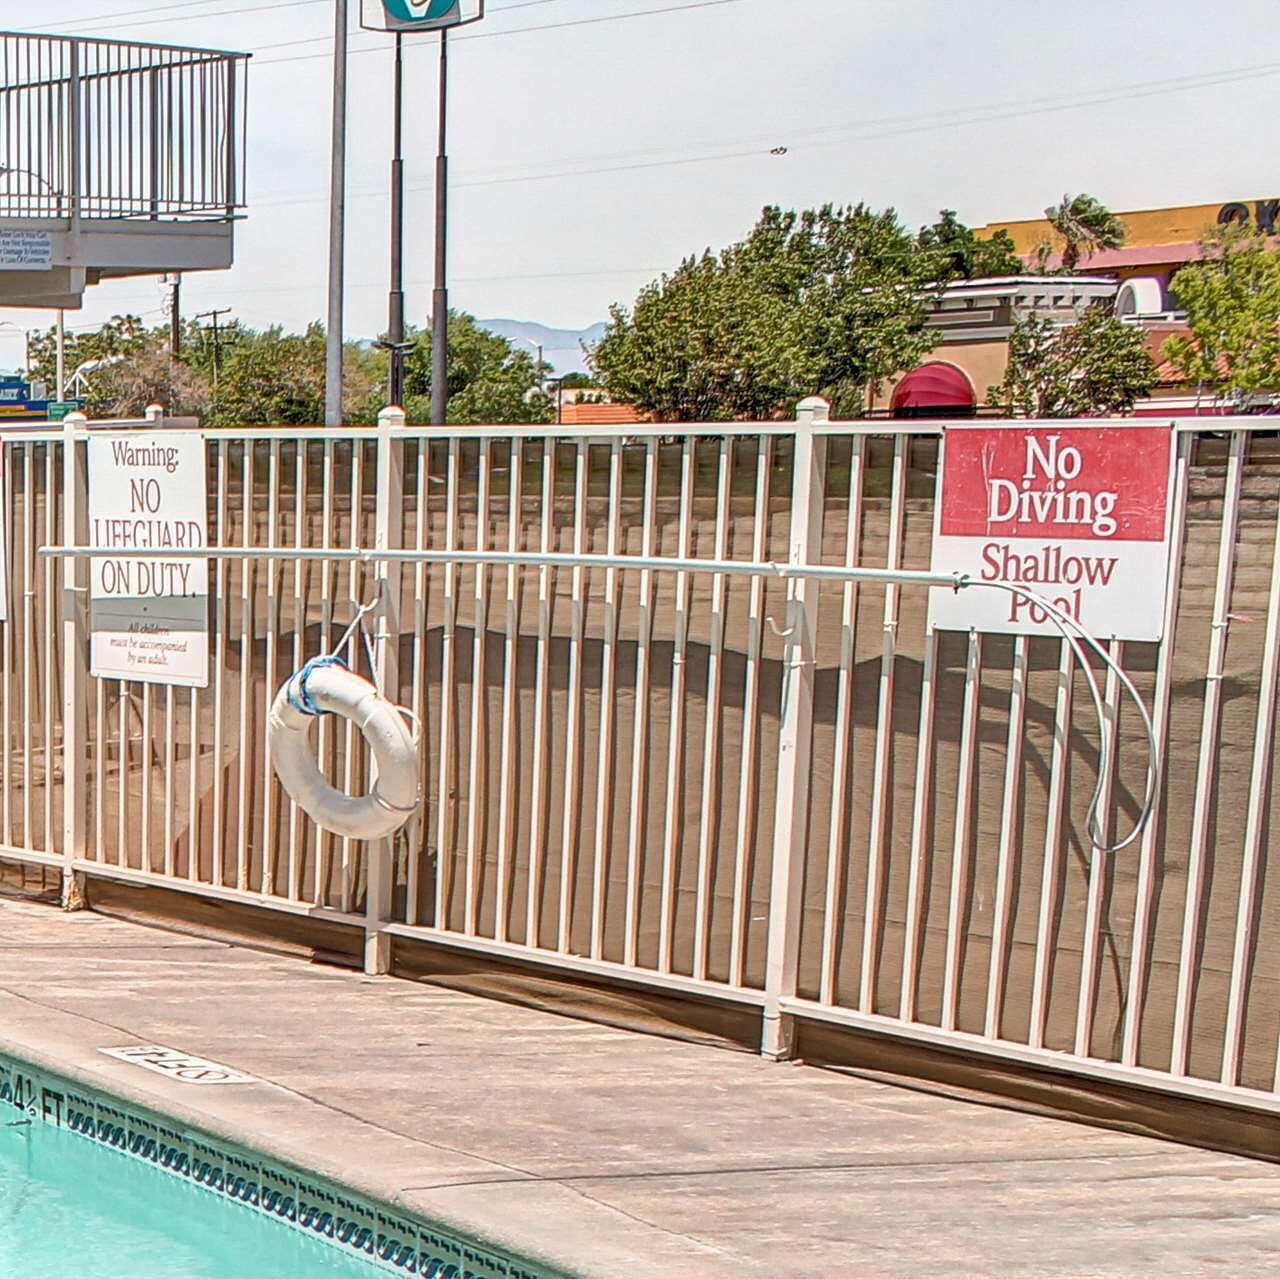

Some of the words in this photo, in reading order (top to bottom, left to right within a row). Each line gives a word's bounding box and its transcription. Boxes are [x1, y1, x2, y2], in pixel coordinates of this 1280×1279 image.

[111, 440, 179, 473] Warning:
[1022, 434, 1082, 480] No
[129, 478, 161, 514] NO
[987, 478, 1118, 537] Diving
[94, 518, 202, 548] LIFEGUARD
[101, 560, 131, 595] ON
[136, 561, 197, 598] DUTY.
[980, 543, 1118, 587] Shallow
[1008, 585, 1083, 625] Pool
[128, 622, 139, 634] All
[42, 1086, 65, 1127] FT
